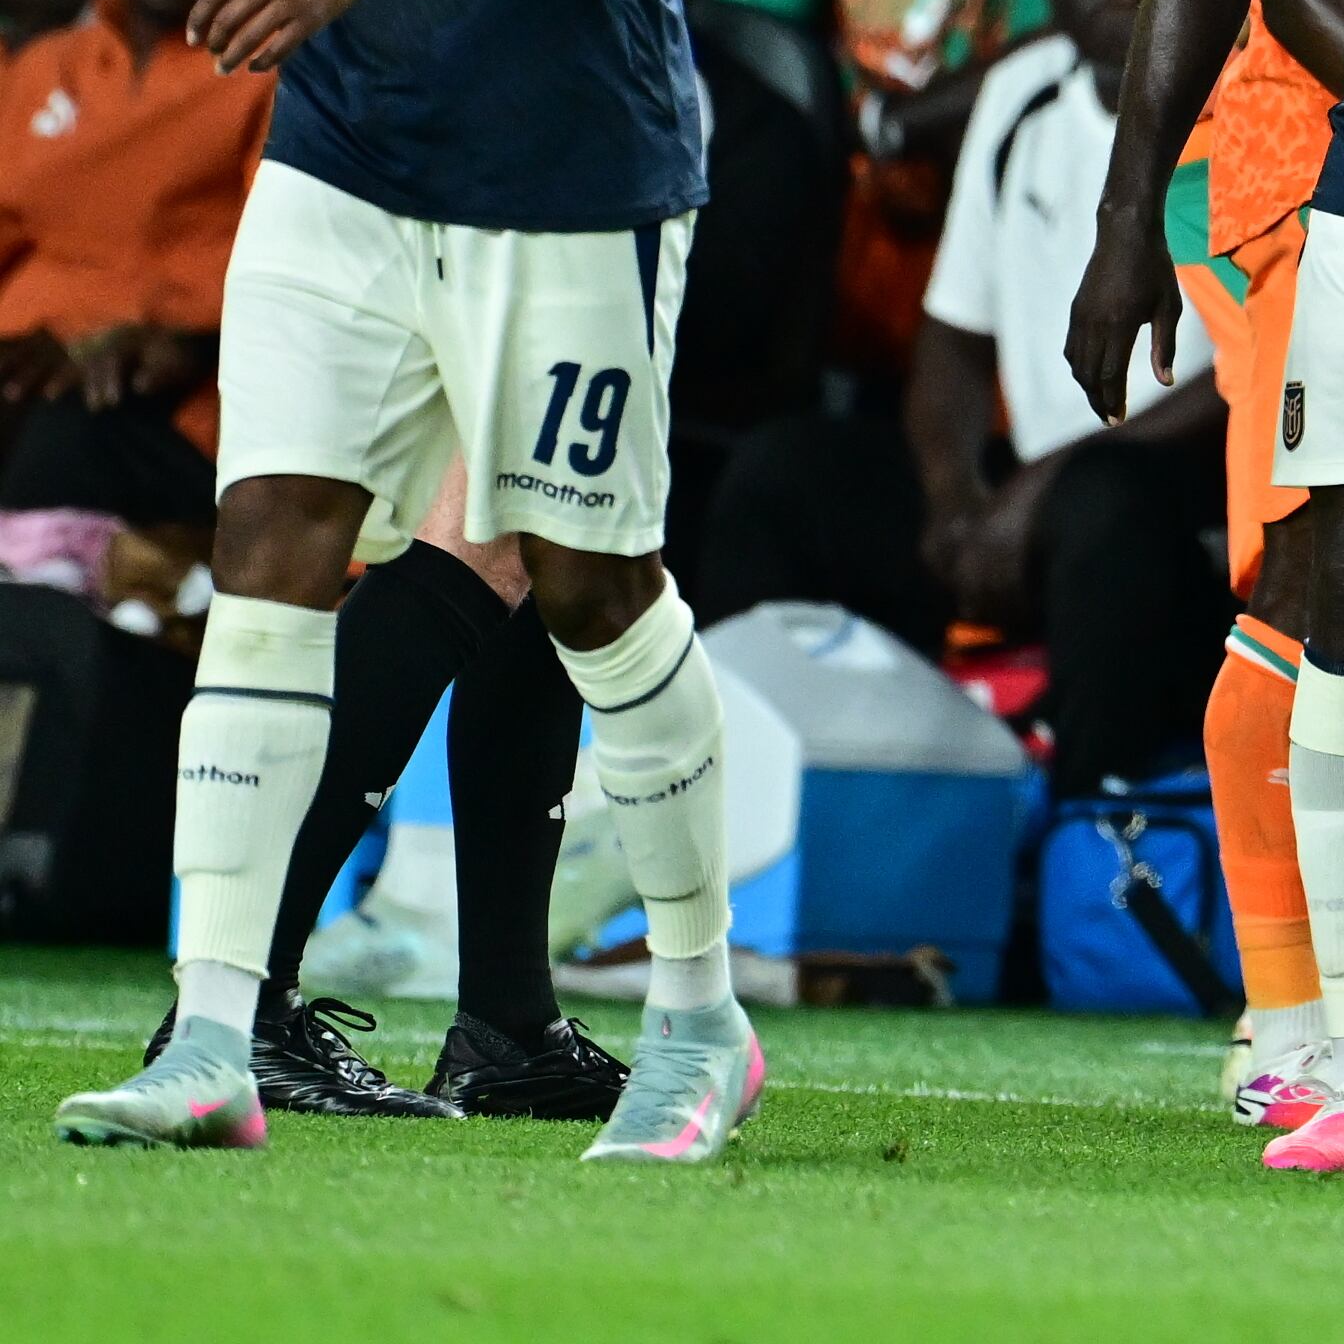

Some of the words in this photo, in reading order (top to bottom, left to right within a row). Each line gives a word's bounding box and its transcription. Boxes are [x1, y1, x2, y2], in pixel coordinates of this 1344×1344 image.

[532, 360, 632, 478] 19
[496, 472, 616, 510] marathon
[178, 764, 260, 787] athon
